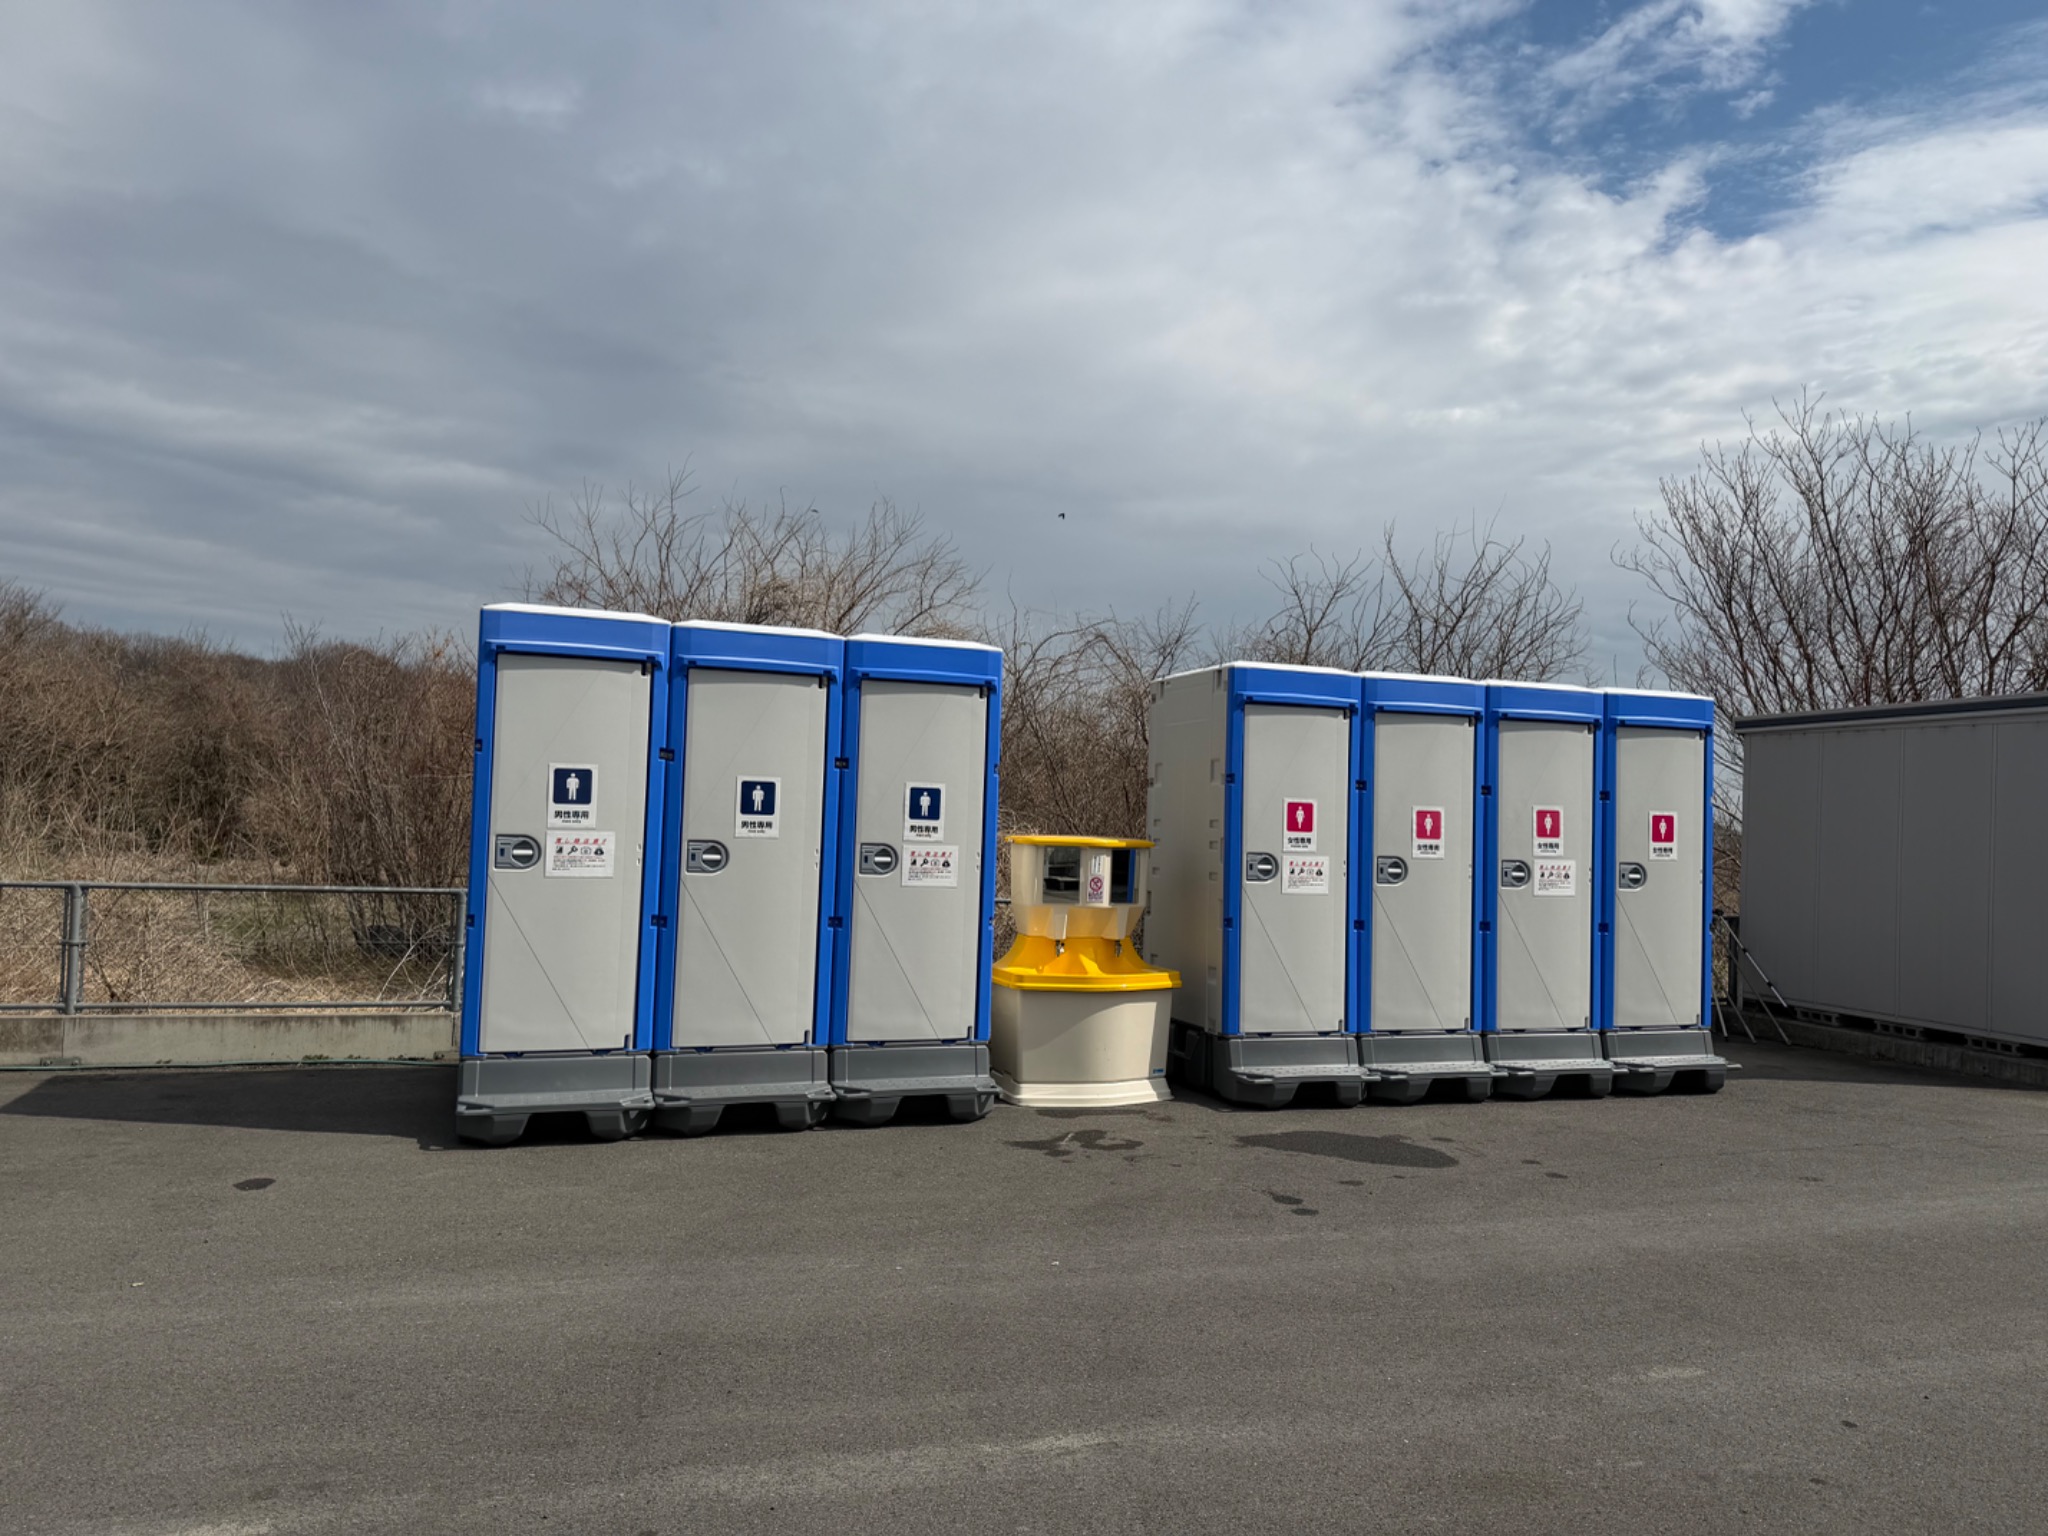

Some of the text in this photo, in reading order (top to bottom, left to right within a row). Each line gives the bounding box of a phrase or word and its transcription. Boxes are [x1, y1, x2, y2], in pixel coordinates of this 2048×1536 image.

[554, 810, 590, 820] 男性専用
[741, 820, 773, 830] 男性専用
[909, 825, 939, 834] 男性専用
